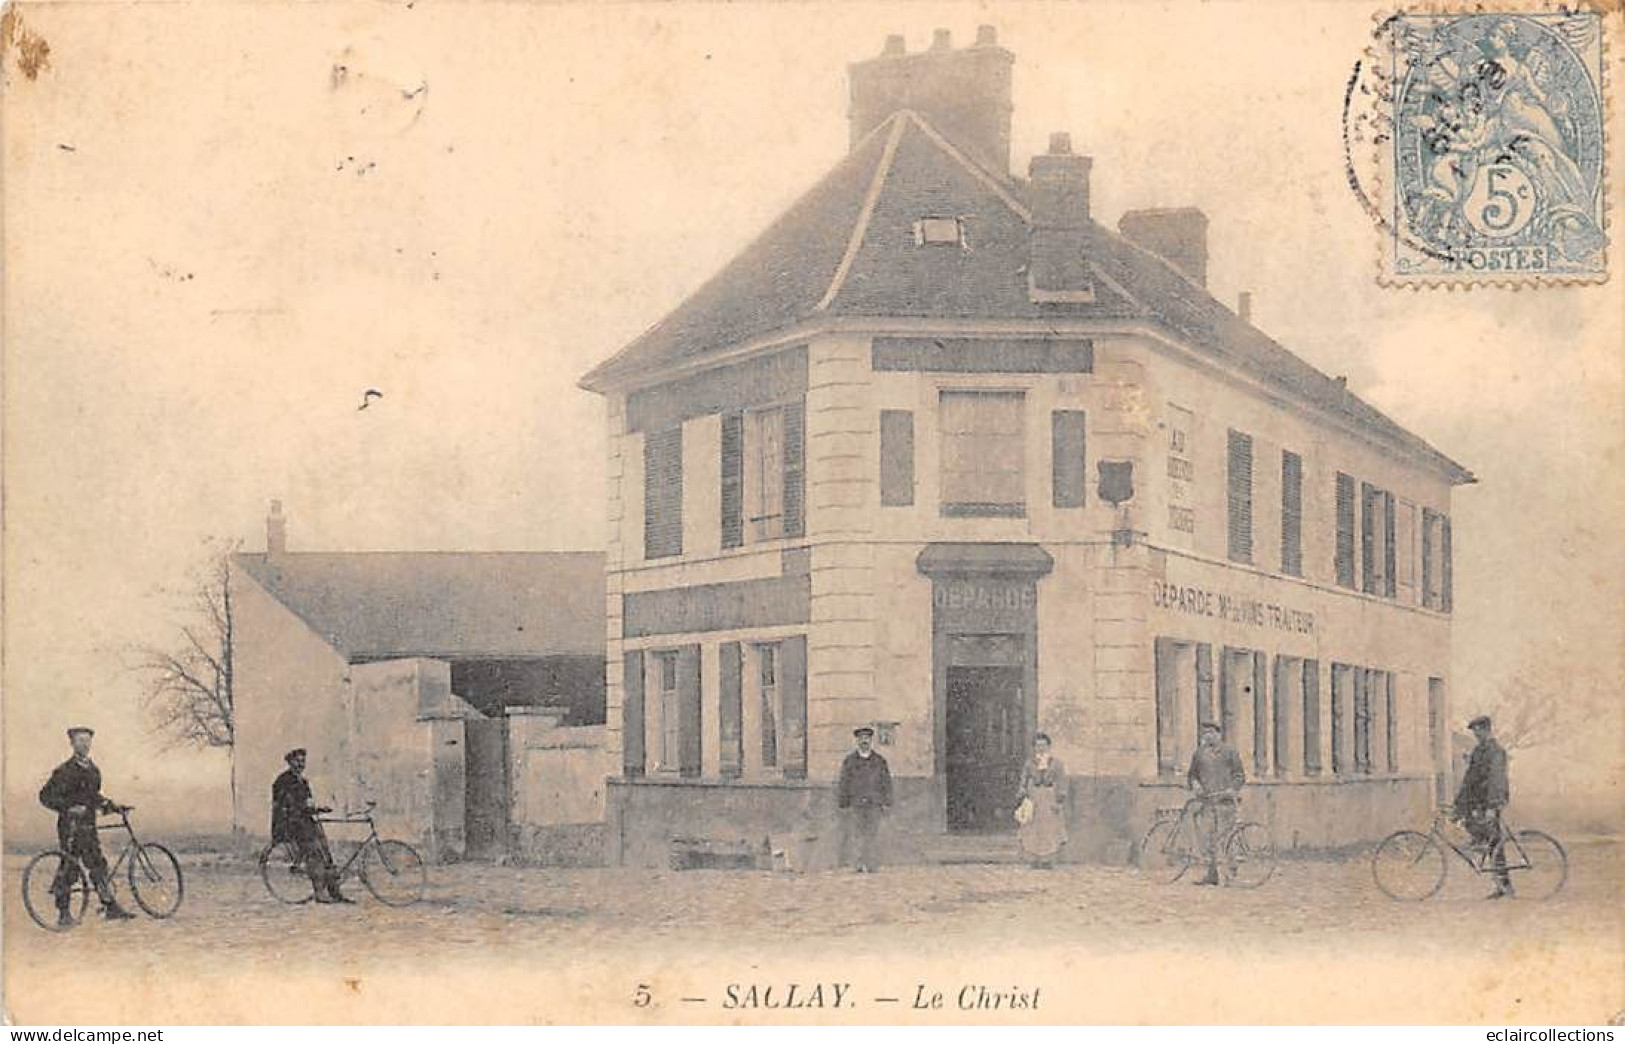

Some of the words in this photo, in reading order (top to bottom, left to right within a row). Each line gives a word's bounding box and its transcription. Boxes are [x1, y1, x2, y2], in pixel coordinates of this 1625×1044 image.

[1456, 249, 1544, 270] POSTES
[935, 585, 1036, 609] DEPARDE
[1153, 581, 1213, 617] DEPARDE
